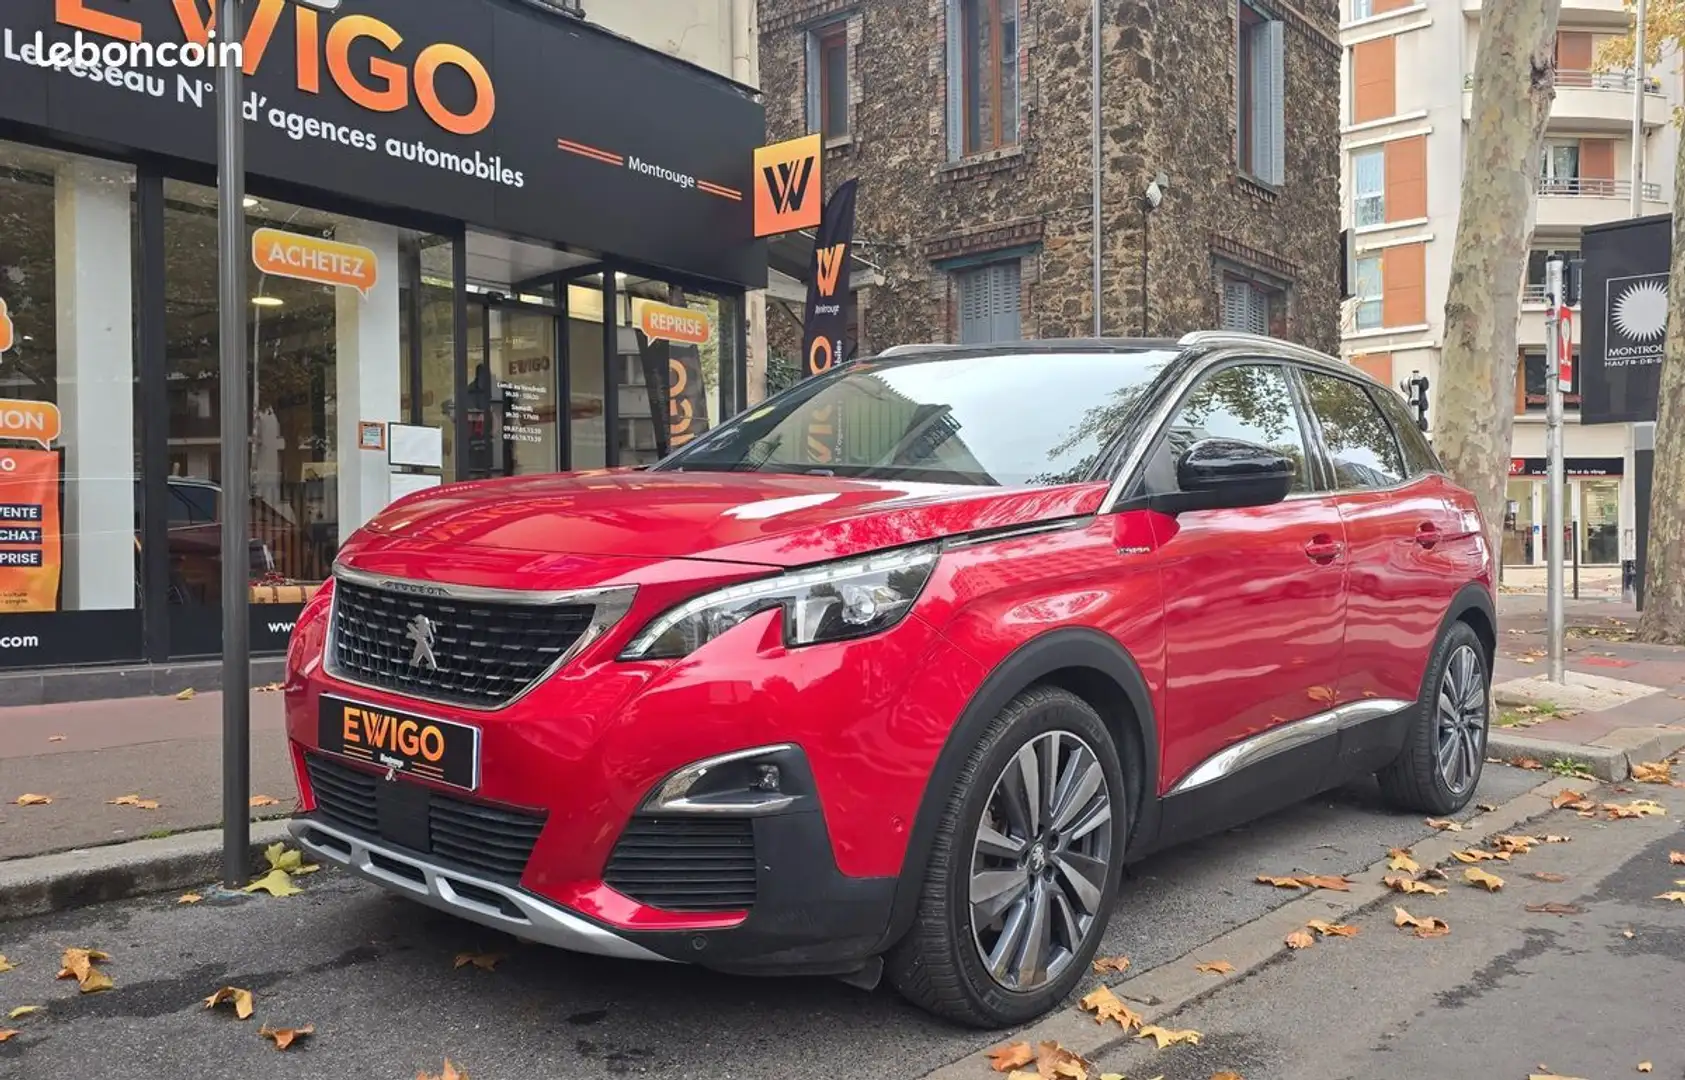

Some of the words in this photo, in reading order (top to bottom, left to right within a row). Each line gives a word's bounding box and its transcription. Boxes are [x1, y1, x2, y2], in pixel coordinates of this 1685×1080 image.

[4, 28, 36, 65] Le
[177, 74, 214, 108] N°
[385, 137, 524, 188] automobiles
[628, 155, 695, 188] Montrouge
[268, 242, 365, 278] ACHETEZ
[650, 312, 702, 336] REPRISE
[0, 553, 39, 564] PRISE
[343, 706, 445, 762] EWIGO
